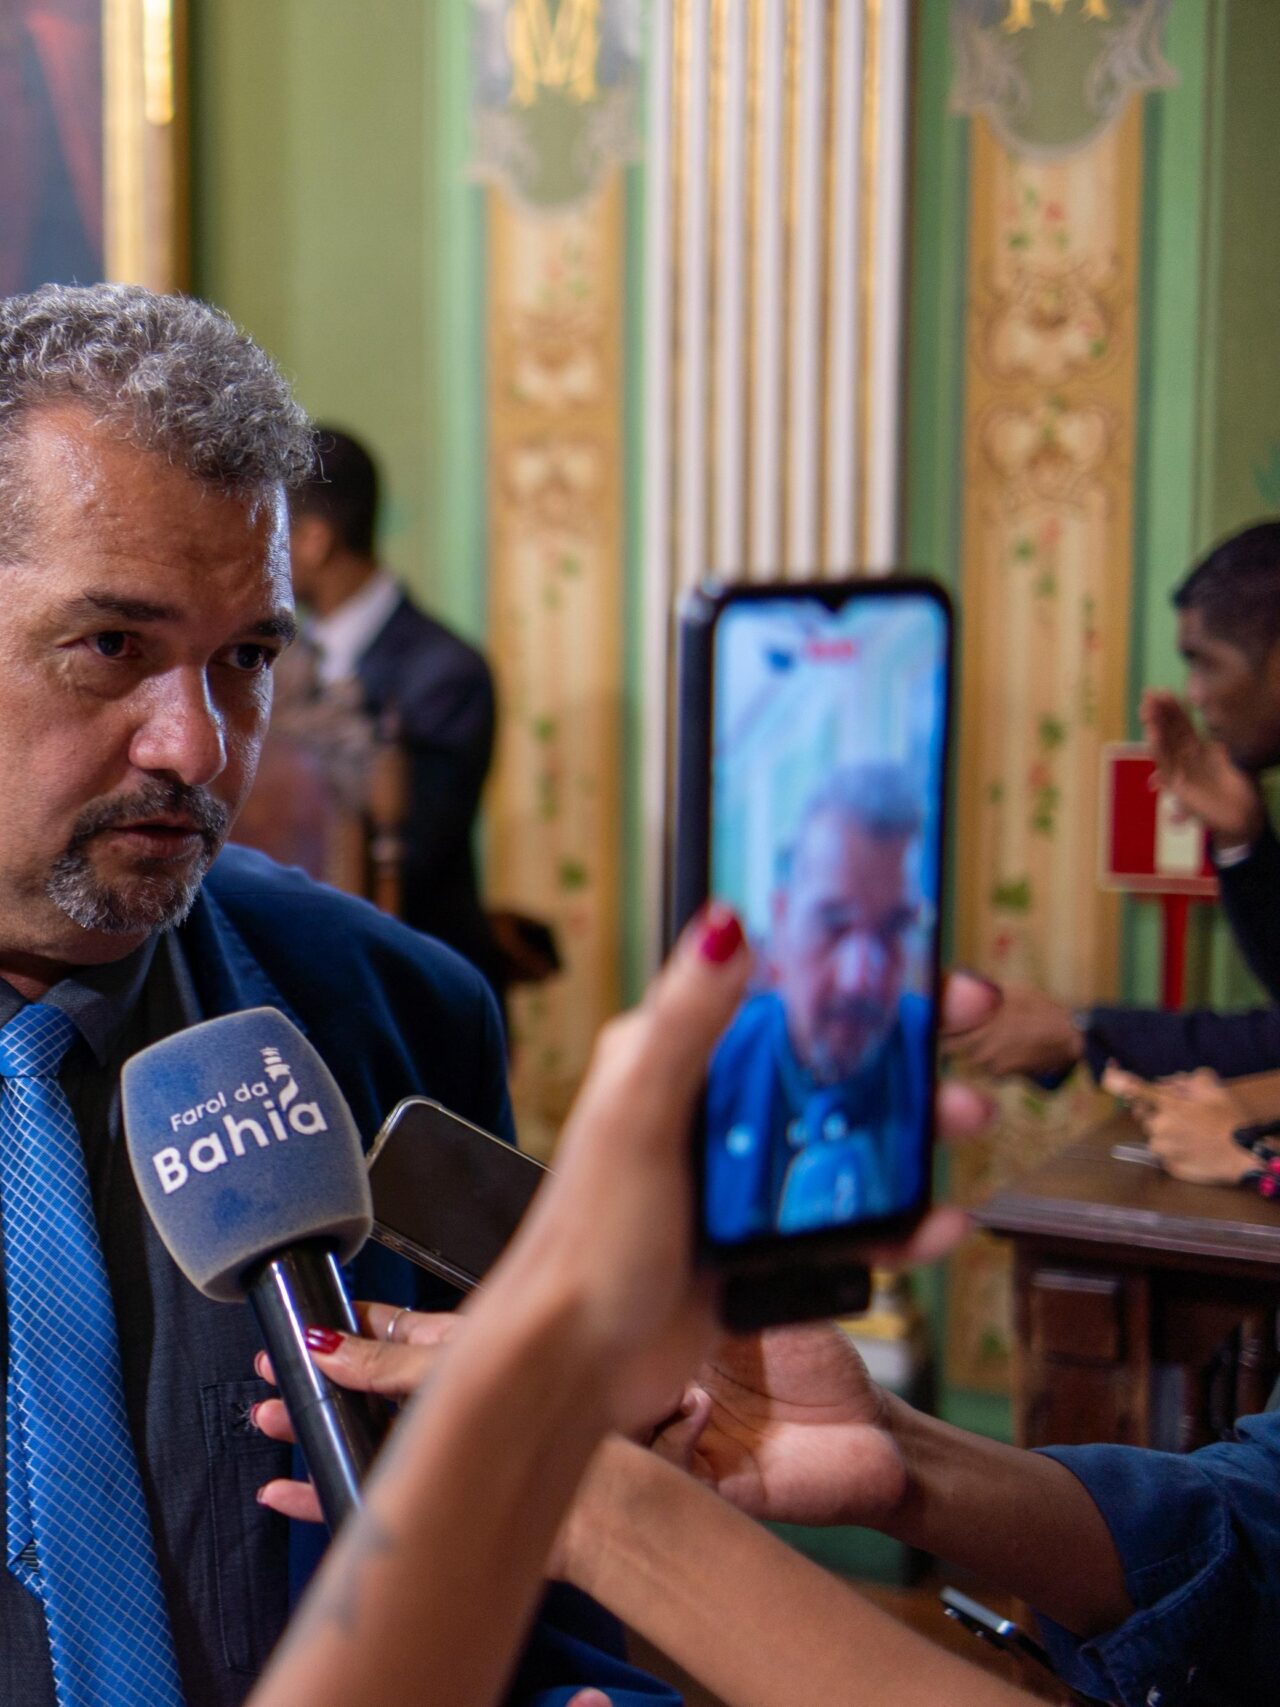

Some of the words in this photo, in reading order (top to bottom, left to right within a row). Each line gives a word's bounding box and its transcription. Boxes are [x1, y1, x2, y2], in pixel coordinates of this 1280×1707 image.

[170, 1092, 227, 1132] Farol
[234, 1081, 269, 1102] da
[152, 1100, 328, 1194] Bahia
